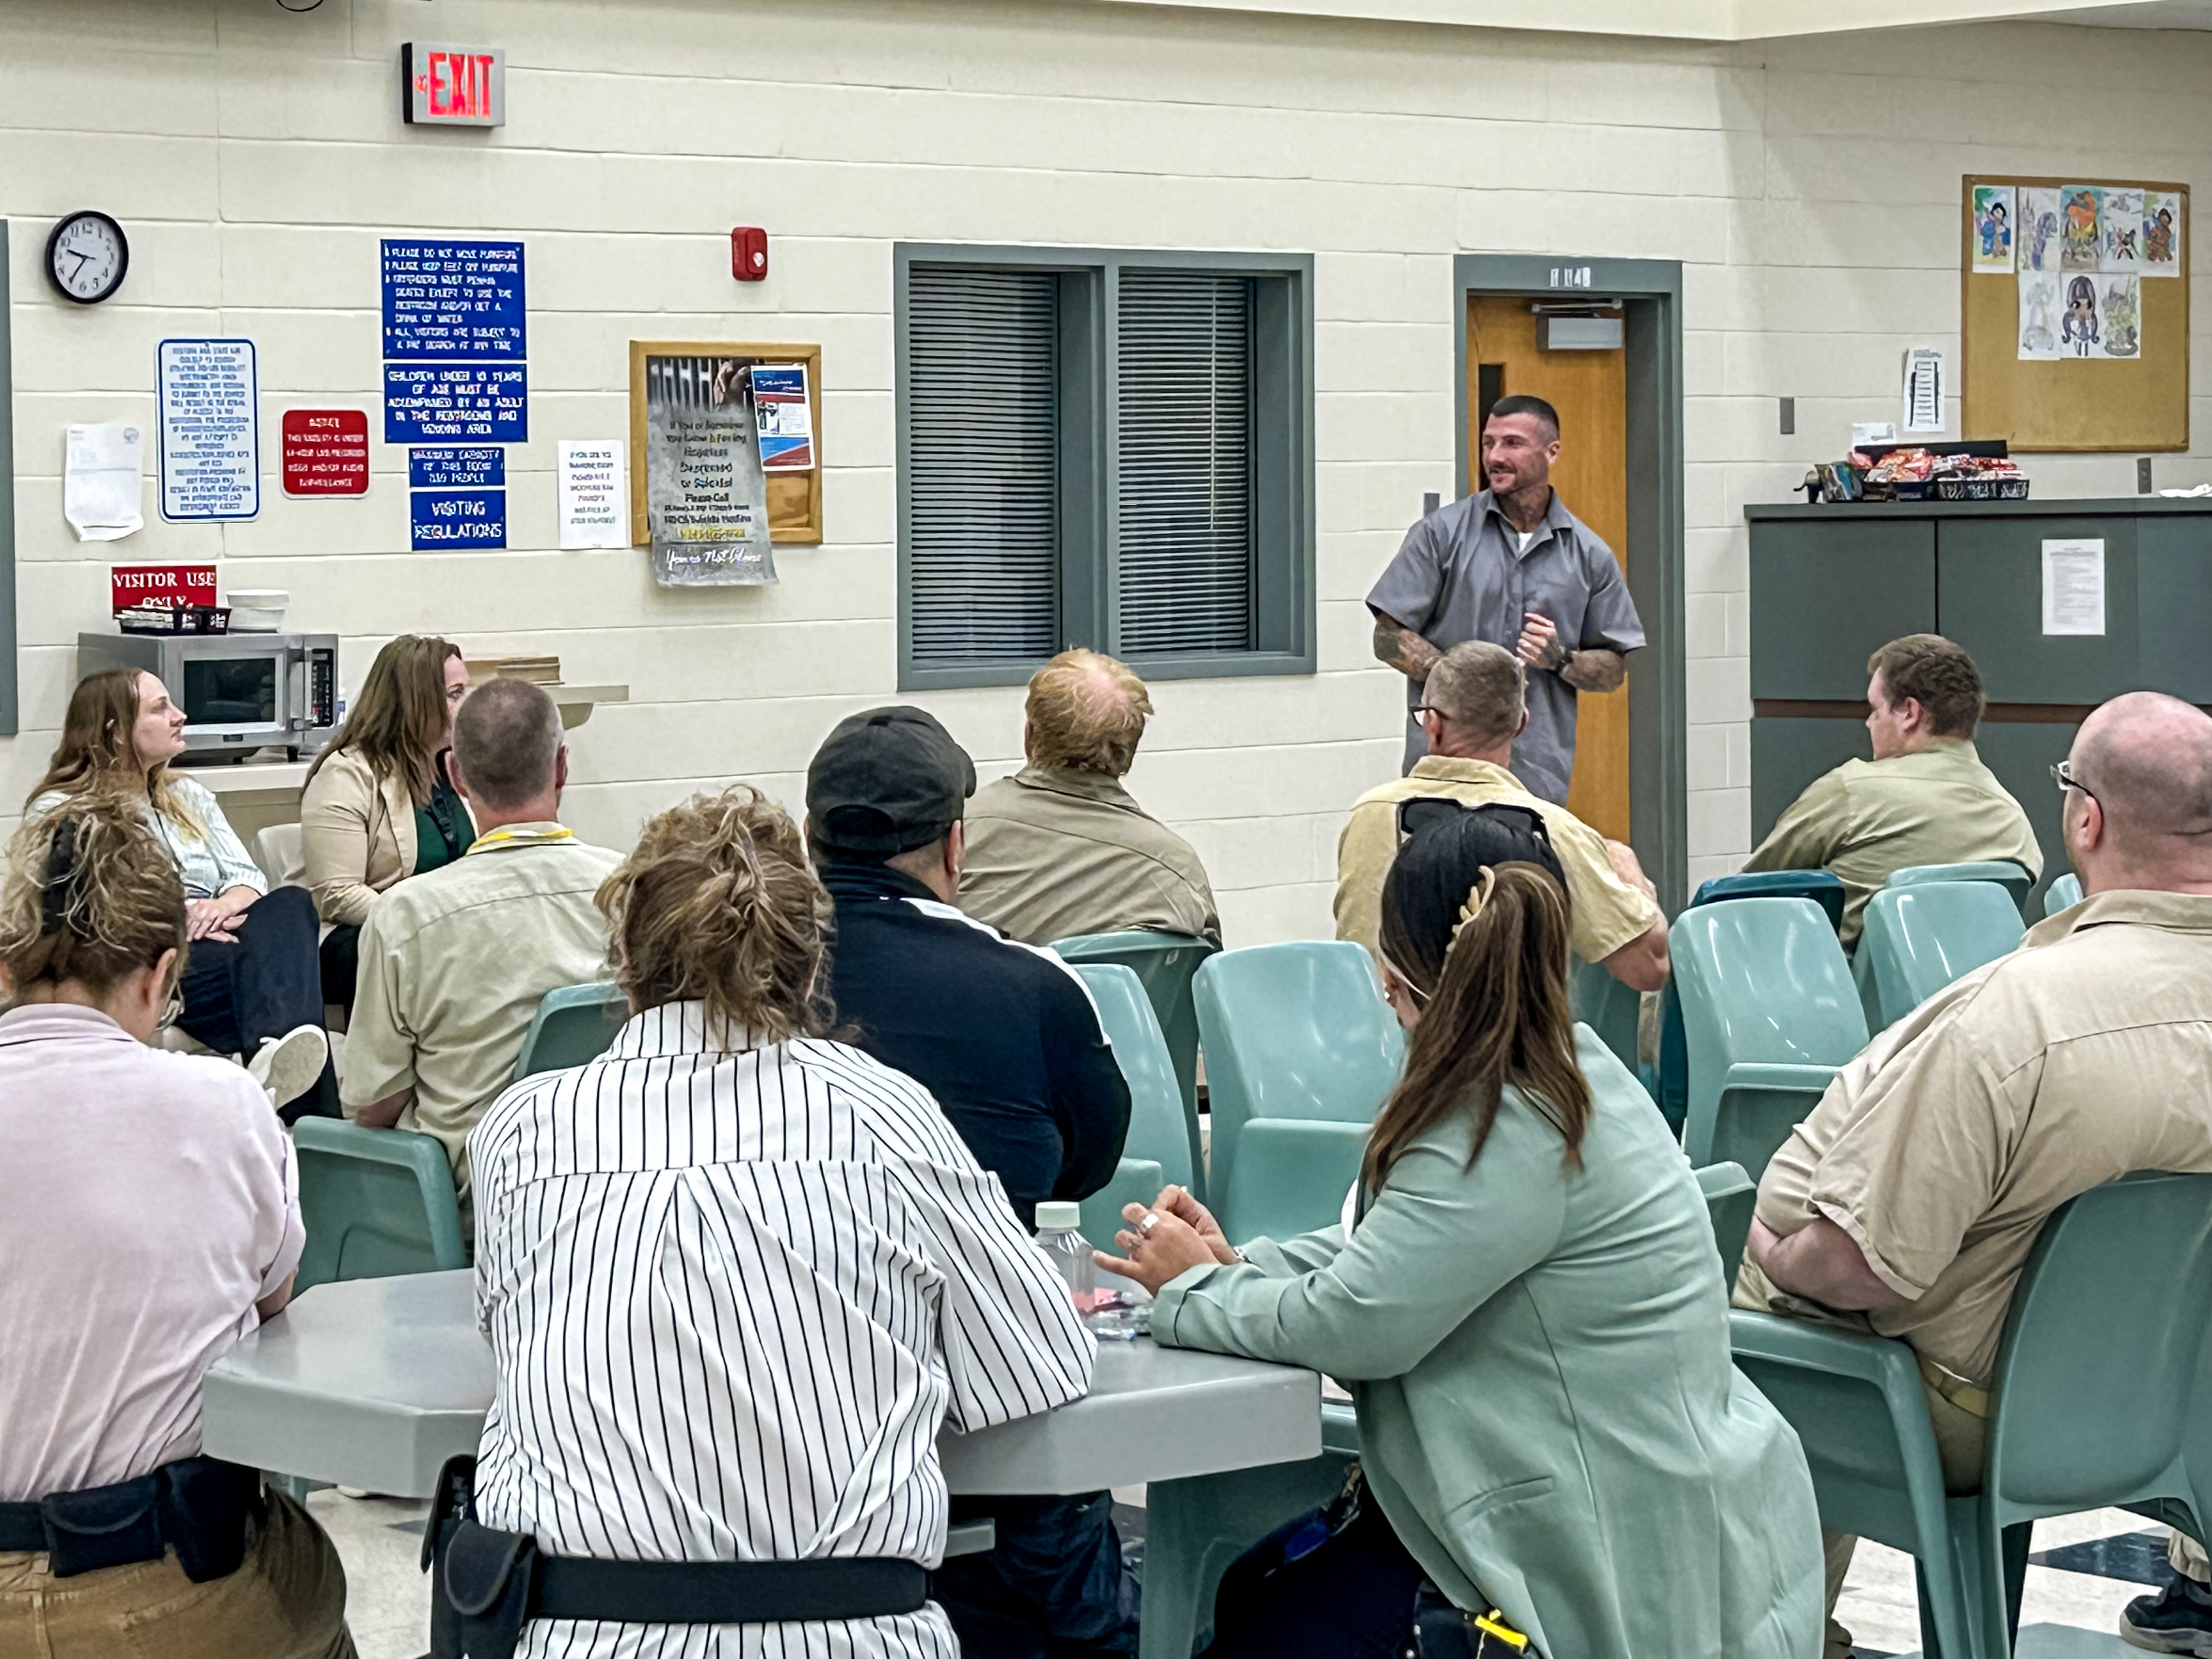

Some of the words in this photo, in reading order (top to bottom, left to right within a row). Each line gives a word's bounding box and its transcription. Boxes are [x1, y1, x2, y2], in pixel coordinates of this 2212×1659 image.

[427, 52, 494, 119] EXIT
[431, 501, 486, 516] VISITING
[414, 523, 502, 539] REGULATIONS
[113, 572, 177, 587] VISITOR
[187, 571, 215, 586] USE
